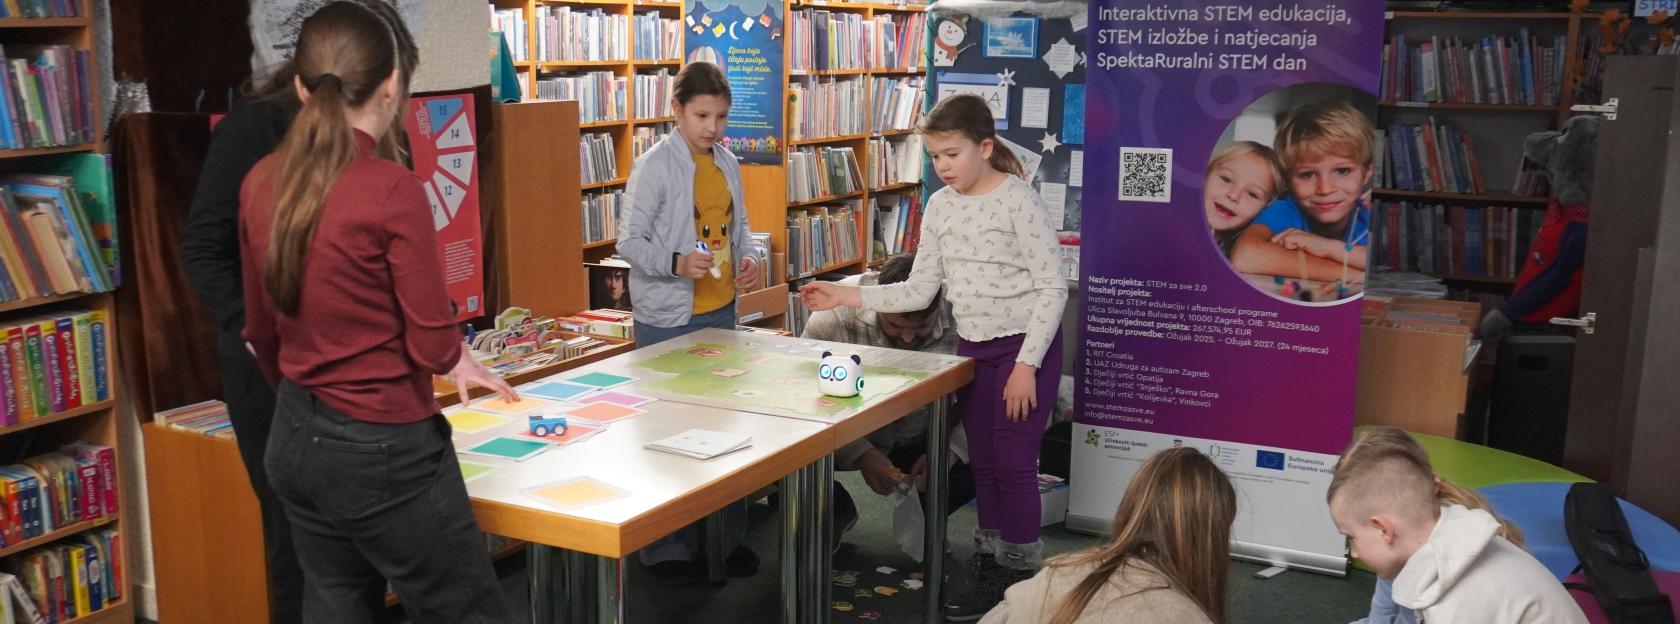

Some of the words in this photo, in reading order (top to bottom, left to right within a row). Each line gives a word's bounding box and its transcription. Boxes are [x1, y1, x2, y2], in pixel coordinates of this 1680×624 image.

[1099, 6, 1198, 21] Interaktivna
[1204, 6, 1253, 21] STEM
[1259, 6, 1352, 25] edukacija,
[1098, 29, 1142, 44] STEM
[1148, 28, 1209, 45] izložbe
[1214, 30, 1218, 44] i
[1224, 30, 1317, 49] natjecanja
[1097, 52, 1213, 71] SpektaRuralni
[1218, 54, 1267, 70] STEM
[1273, 54, 1307, 70] dan
[439, 105, 447, 116] 15
[450, 129, 460, 139] 14
[453, 158, 462, 168] 13
[444, 185, 453, 196] 12
[1088, 276, 1108, 284] Naziv
[1110, 278, 1144, 287] projekta:
[1146, 280, 1167, 288] STEM
[1088, 285, 1116, 295] Nositelj
[1118, 288, 1152, 298] projekta:
[1088, 296, 1114, 304] Institut
[1126, 298, 1146, 306] STEM
[1148, 301, 1185, 310] edukaciju
[1192, 304, 1236, 314] afterschool
[1238, 309, 1278, 318] programe
[1087, 315, 1115, 324] Ukupna
[1116, 318, 1155, 328] vrijednost
[1156, 322, 1191, 332] projekta:
[1235, 328, 1252, 336] EUR
[1088, 306, 1106, 314] Ulica
[1108, 307, 1146, 317] Slavoljuba
[1148, 310, 1178, 319] Bulvana
[1180, 313, 1186, 322] 9,
[1188, 314, 1213, 323] 10000
[1214, 316, 1246, 327] Zagreb,
[1248, 319, 1264, 327] OIB:
[1267, 320, 1320, 332] 76262593640
[1086, 340, 1115, 348] Partneri
[1087, 324, 1124, 335] Razdoblje
[1125, 329, 1165, 338] provedbe:
[1166, 332, 1192, 342] Ožujak
[1194, 334, 1216, 344] 2025.
[1225, 337, 1252, 348] Ožujak
[1254, 341, 1276, 349] 2027.
[1278, 342, 1290, 351] (24
[1292, 344, 1330, 355] mjeseca)
[1106, 352, 1134, 360] Croatia
[1086, 358, 1092, 366] 2.
[1094, 360, 1109, 368] UAZ
[1111, 362, 1138, 372] Udruga
[1151, 366, 1180, 375] autizam
[1182, 368, 1210, 378] Zagreb
[1118, 372, 1134, 380] vrtić
[1136, 373, 1164, 383] Opatija
[1118, 381, 1134, 390] vrtić
[1176, 387, 1198, 396] Ravna
[1200, 390, 1219, 398] Gora
[1118, 390, 1134, 398] vrtić
[1180, 399, 1211, 408] Vinkovci
[1085, 402, 1155, 415] www.stemzasve.eu
[1084, 411, 1154, 424] info@stemzasve.eu
[1288, 456, 1324, 466] Sufinancira
[1288, 463, 1318, 472] Europska
